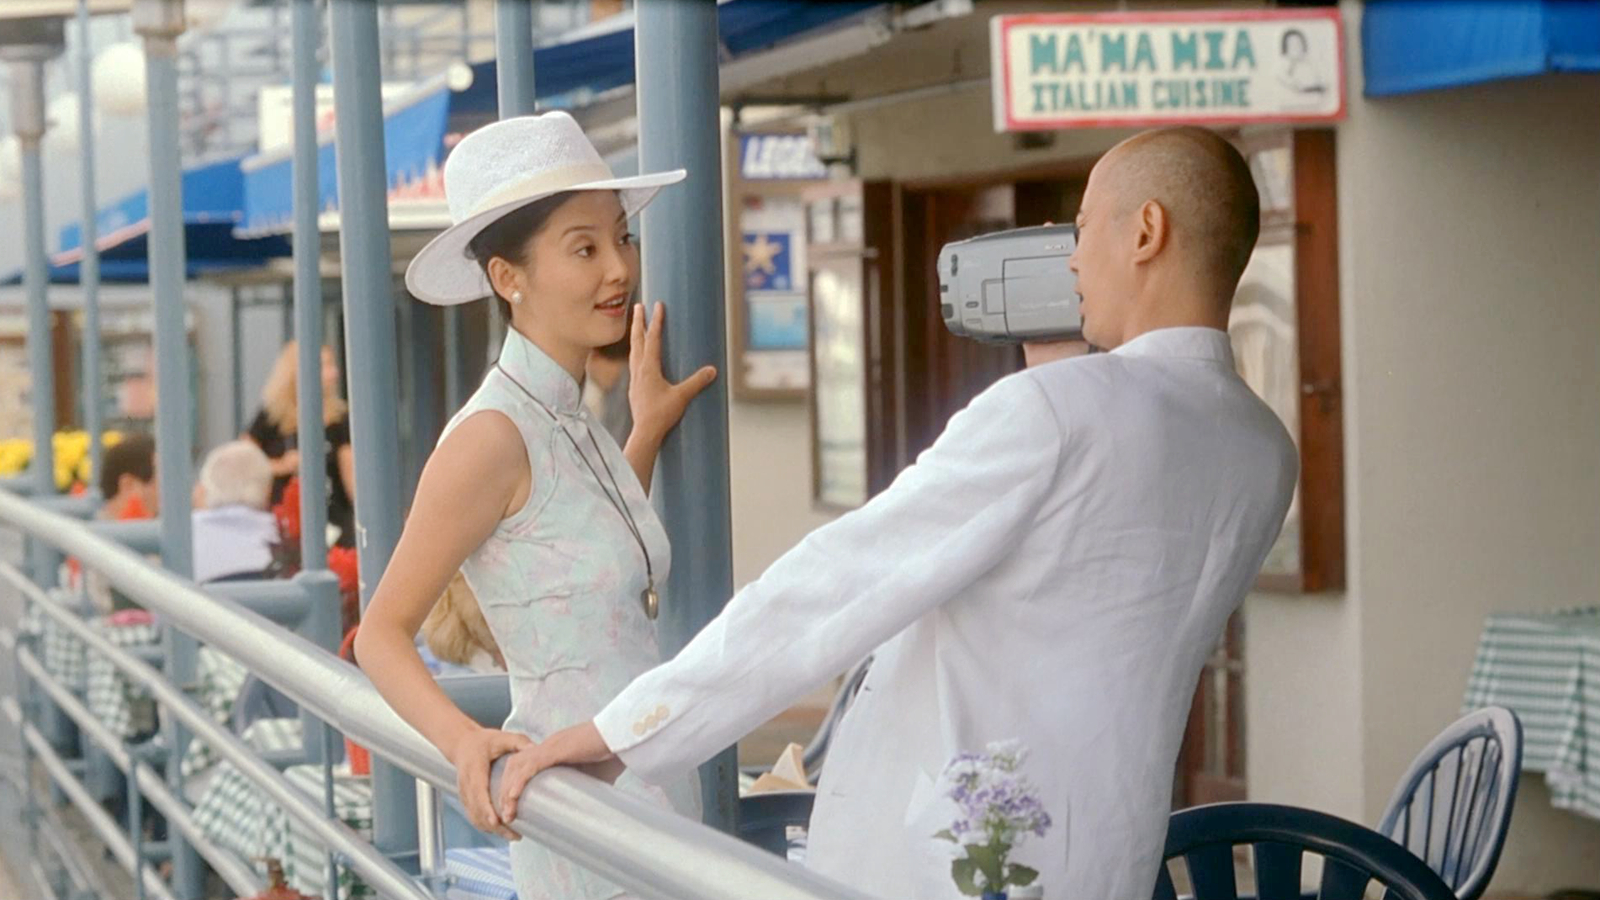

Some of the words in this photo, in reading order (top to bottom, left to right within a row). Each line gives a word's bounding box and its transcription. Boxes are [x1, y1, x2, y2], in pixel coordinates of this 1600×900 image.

[1030, 29, 1158, 74] MA'MA
[1170, 30, 1257, 71] MIA
[1032, 81, 1138, 112] ITALIAN
[1152, 78, 1250, 109] CUISINE
